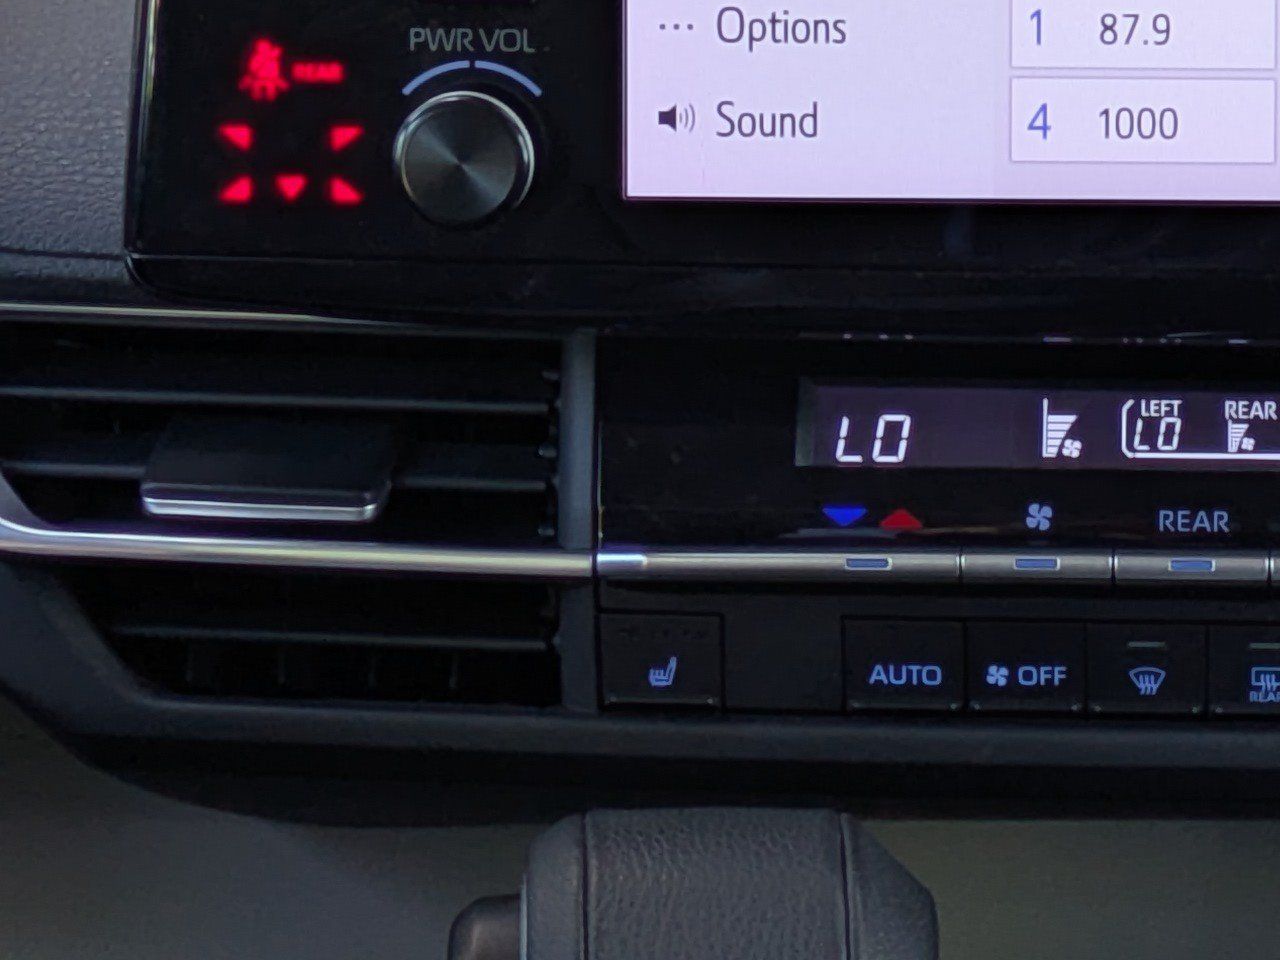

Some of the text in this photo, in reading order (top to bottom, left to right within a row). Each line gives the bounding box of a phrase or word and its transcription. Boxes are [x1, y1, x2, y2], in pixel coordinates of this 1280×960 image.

[409, 27, 536, 53] PWR VOL
[716, 6, 847, 53] Options
[1030, 8, 1171, 46] 1 87.9
[716, 100, 818, 139] Sound
[1027, 102, 1179, 140] 4 1000
[1140, 398, 1183, 418] LEFT
[1224, 400, 1278, 420] REAR
[835, 413, 912, 463] LO
[1158, 509, 1230, 533] REAR
[869, 664, 942, 686] AUTO
[1017, 665, 1067, 686] OFF
